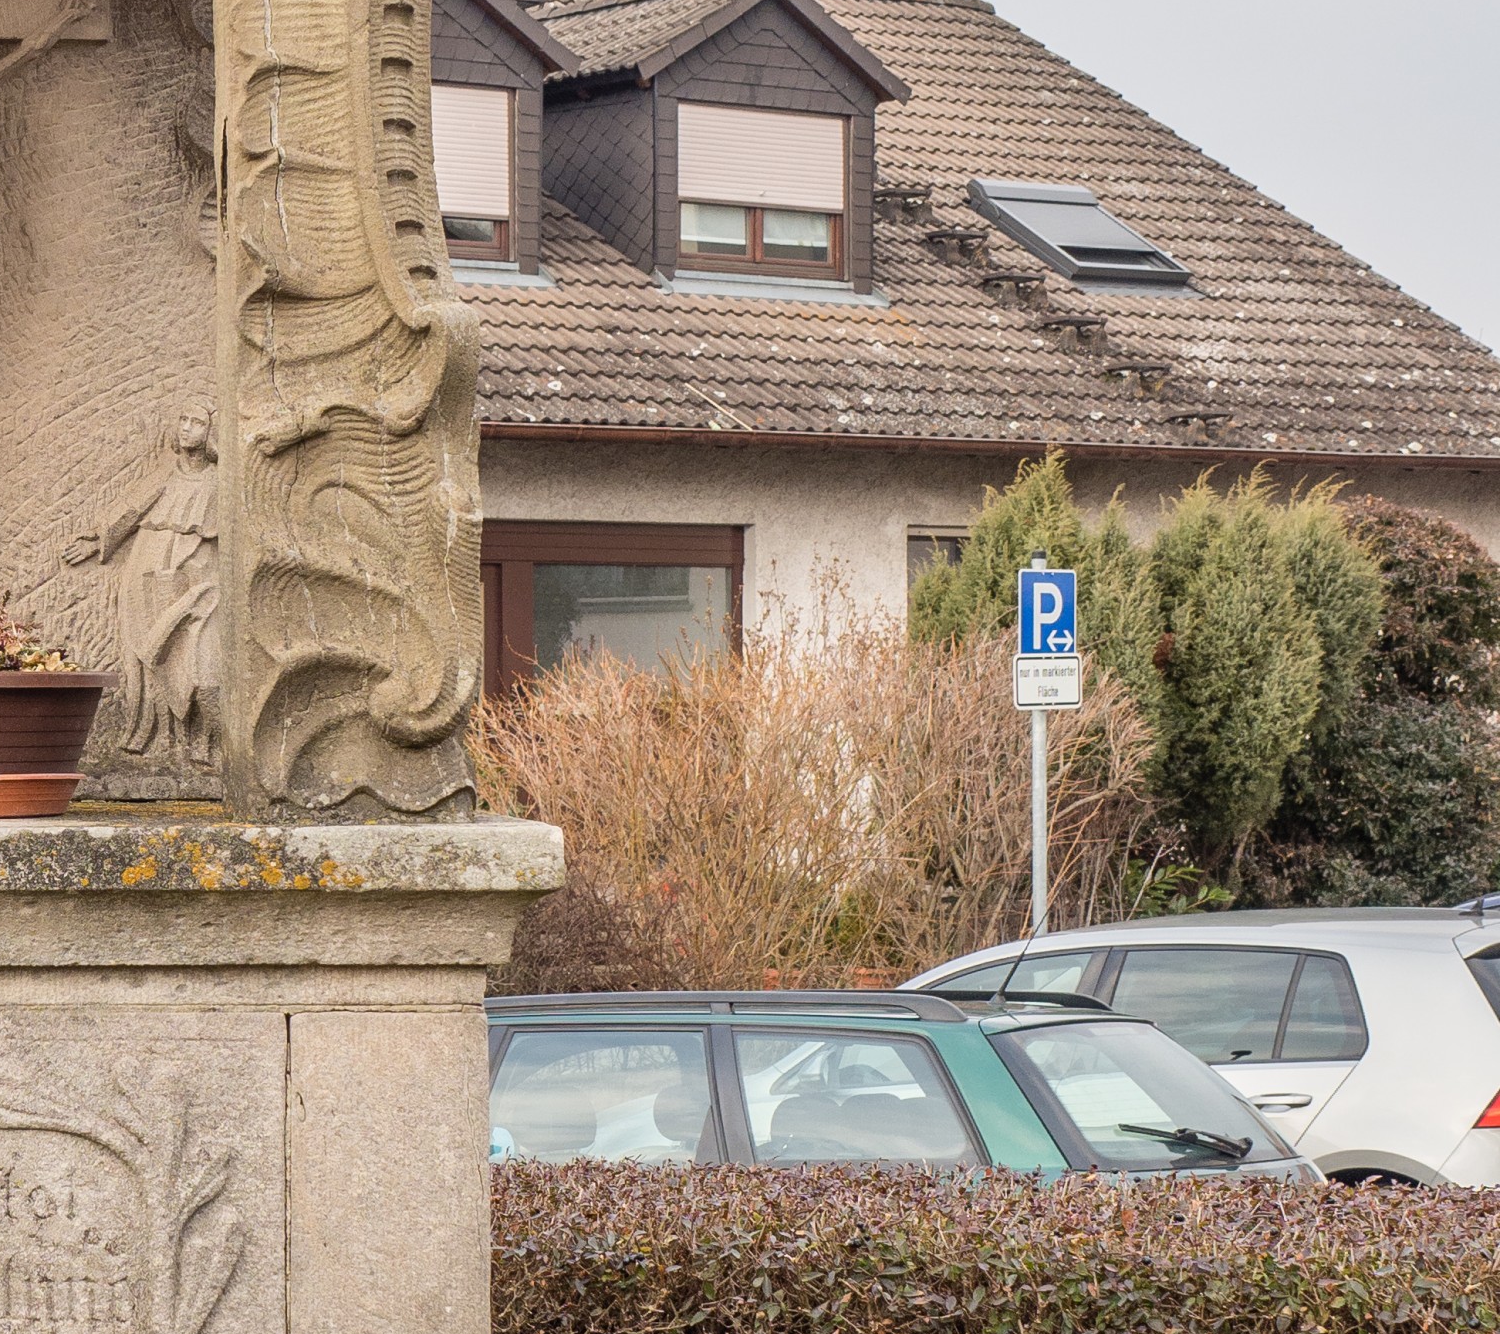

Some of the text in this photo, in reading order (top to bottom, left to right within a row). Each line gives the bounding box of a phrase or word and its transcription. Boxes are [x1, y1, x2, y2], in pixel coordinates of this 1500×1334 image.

[1033, 582, 1063, 650] P
[1020, 666, 1077, 678] nur in markierter
[1037, 685, 1059, 698] Fläche
